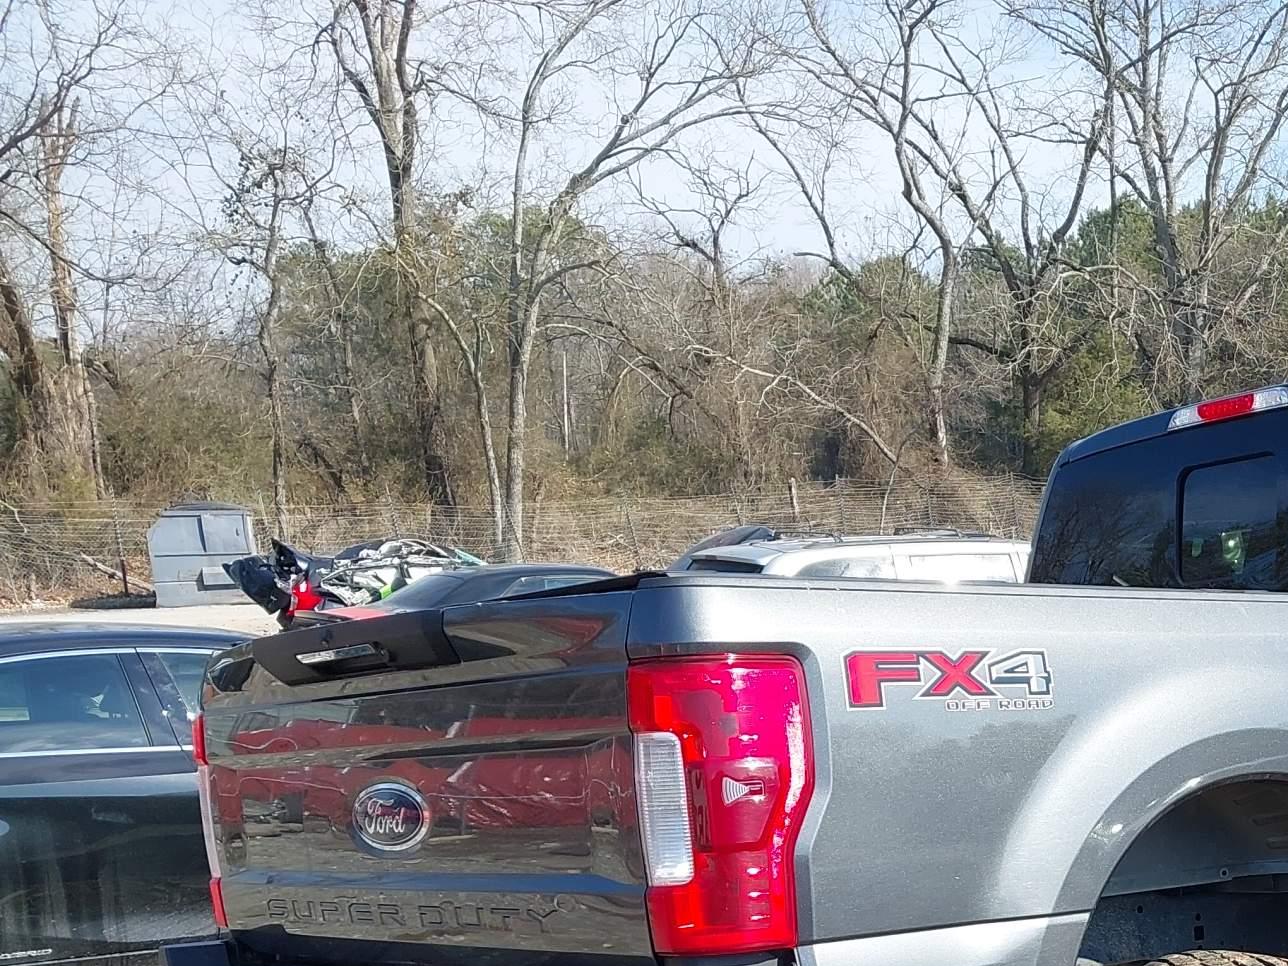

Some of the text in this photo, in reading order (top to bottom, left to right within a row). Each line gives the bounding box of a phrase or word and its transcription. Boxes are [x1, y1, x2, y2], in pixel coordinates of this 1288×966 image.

[842, 649, 1054, 709] FX4
[945, 698, 1054, 711] OFF ROAD
[365, 797, 406, 834] Ford
[266, 898, 558, 934] SUPER DUTY
